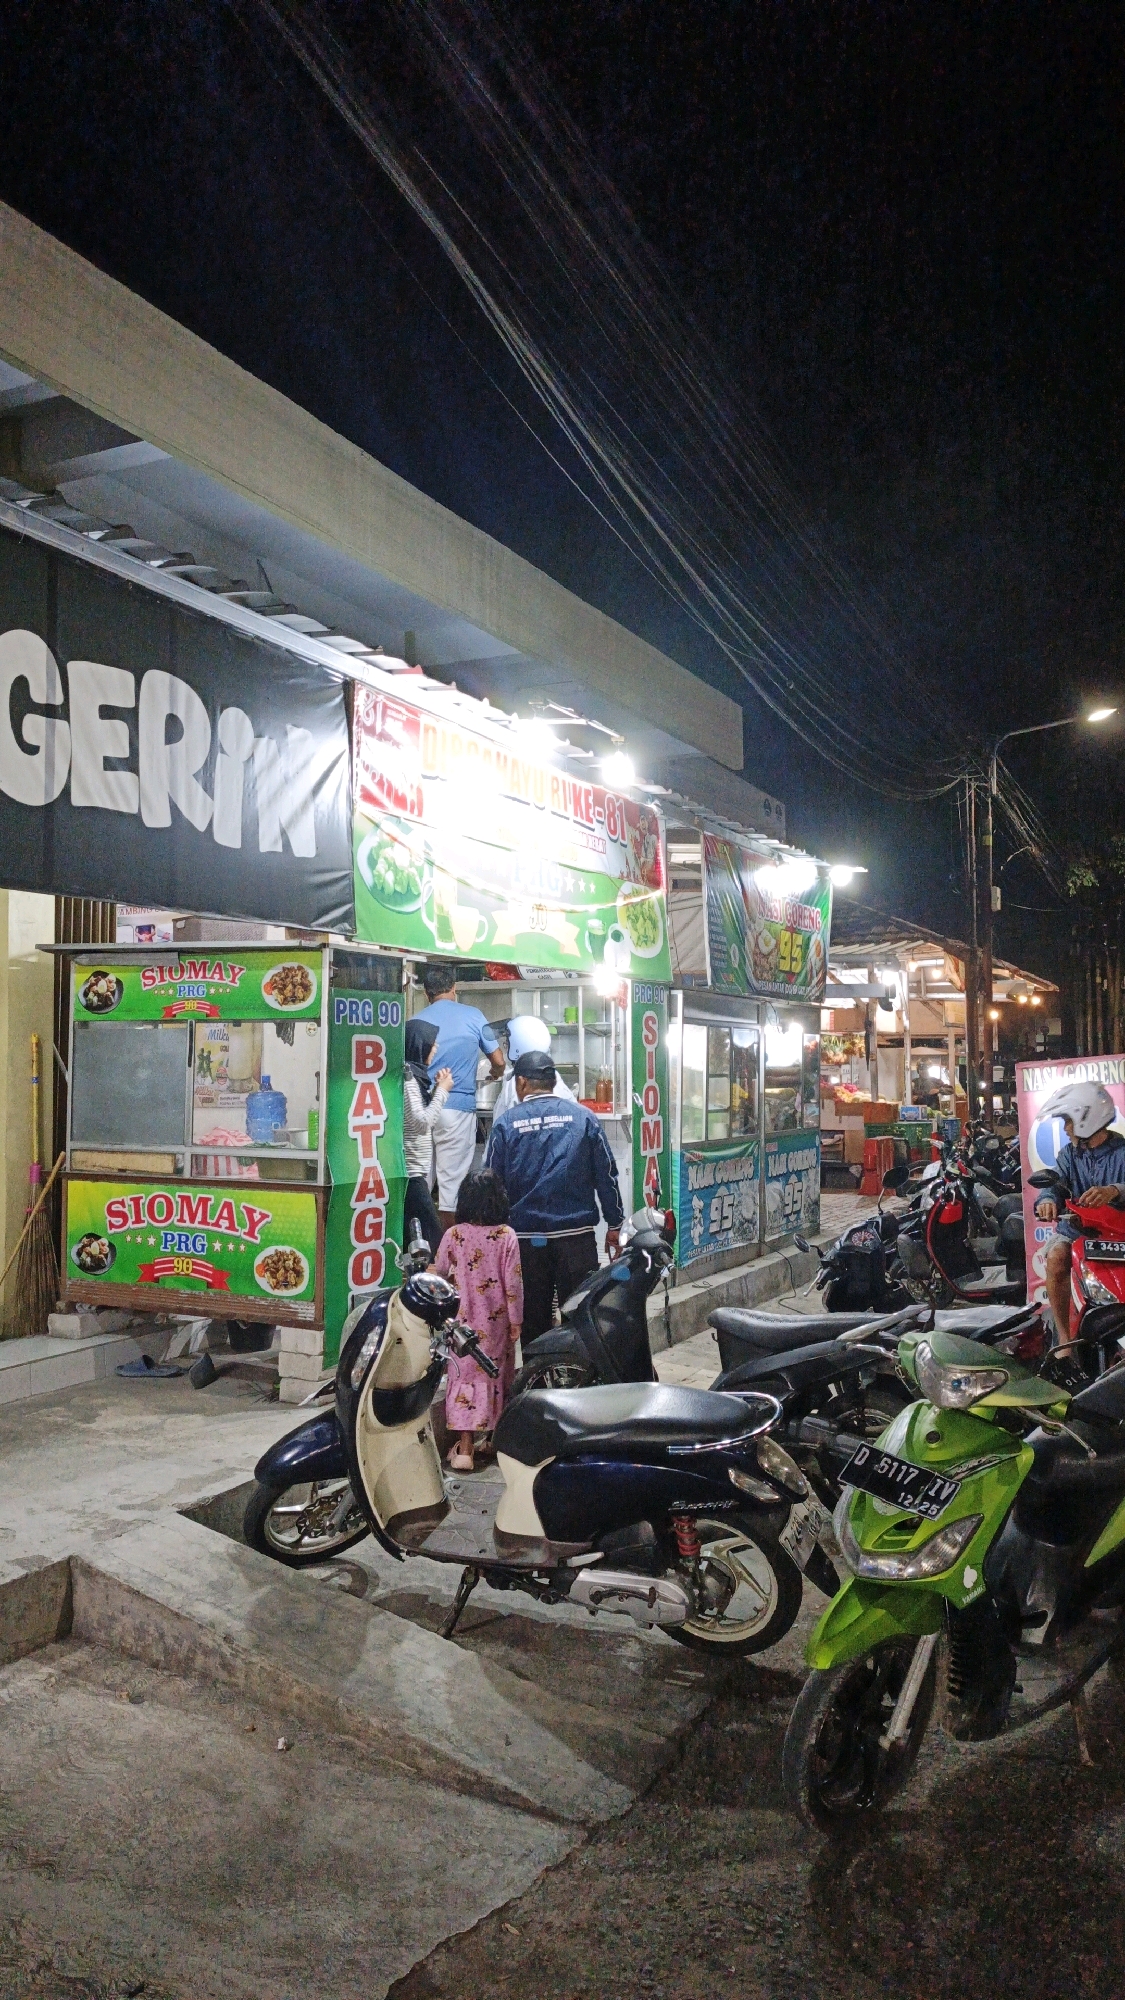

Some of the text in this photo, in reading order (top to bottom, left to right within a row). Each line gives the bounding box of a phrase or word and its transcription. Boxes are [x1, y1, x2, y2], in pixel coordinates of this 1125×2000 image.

[784, 899, 822, 933] GORENG
[779, 929, 803, 973] 95
[141, 960, 246, 989] SIOMAY
[177, 984, 206, 998] PRG
[634, 984, 665, 1004] PRG 90
[184, 1000, 197, 1010] 90
[335, 999, 400, 1025] PRG 90
[1022, 1066, 1058, 1092] NASI
[349, 1038, 387, 1290] BATAGO
[784, 1181, 803, 1217] 95
[105, 1192, 272, 1244] SIOMAY
[709, 1193, 735, 1235] 95
[161, 1231, 207, 1254] PRG
[173, 1257, 193, 1274] 90
[854, 1447, 870, 1466] D
